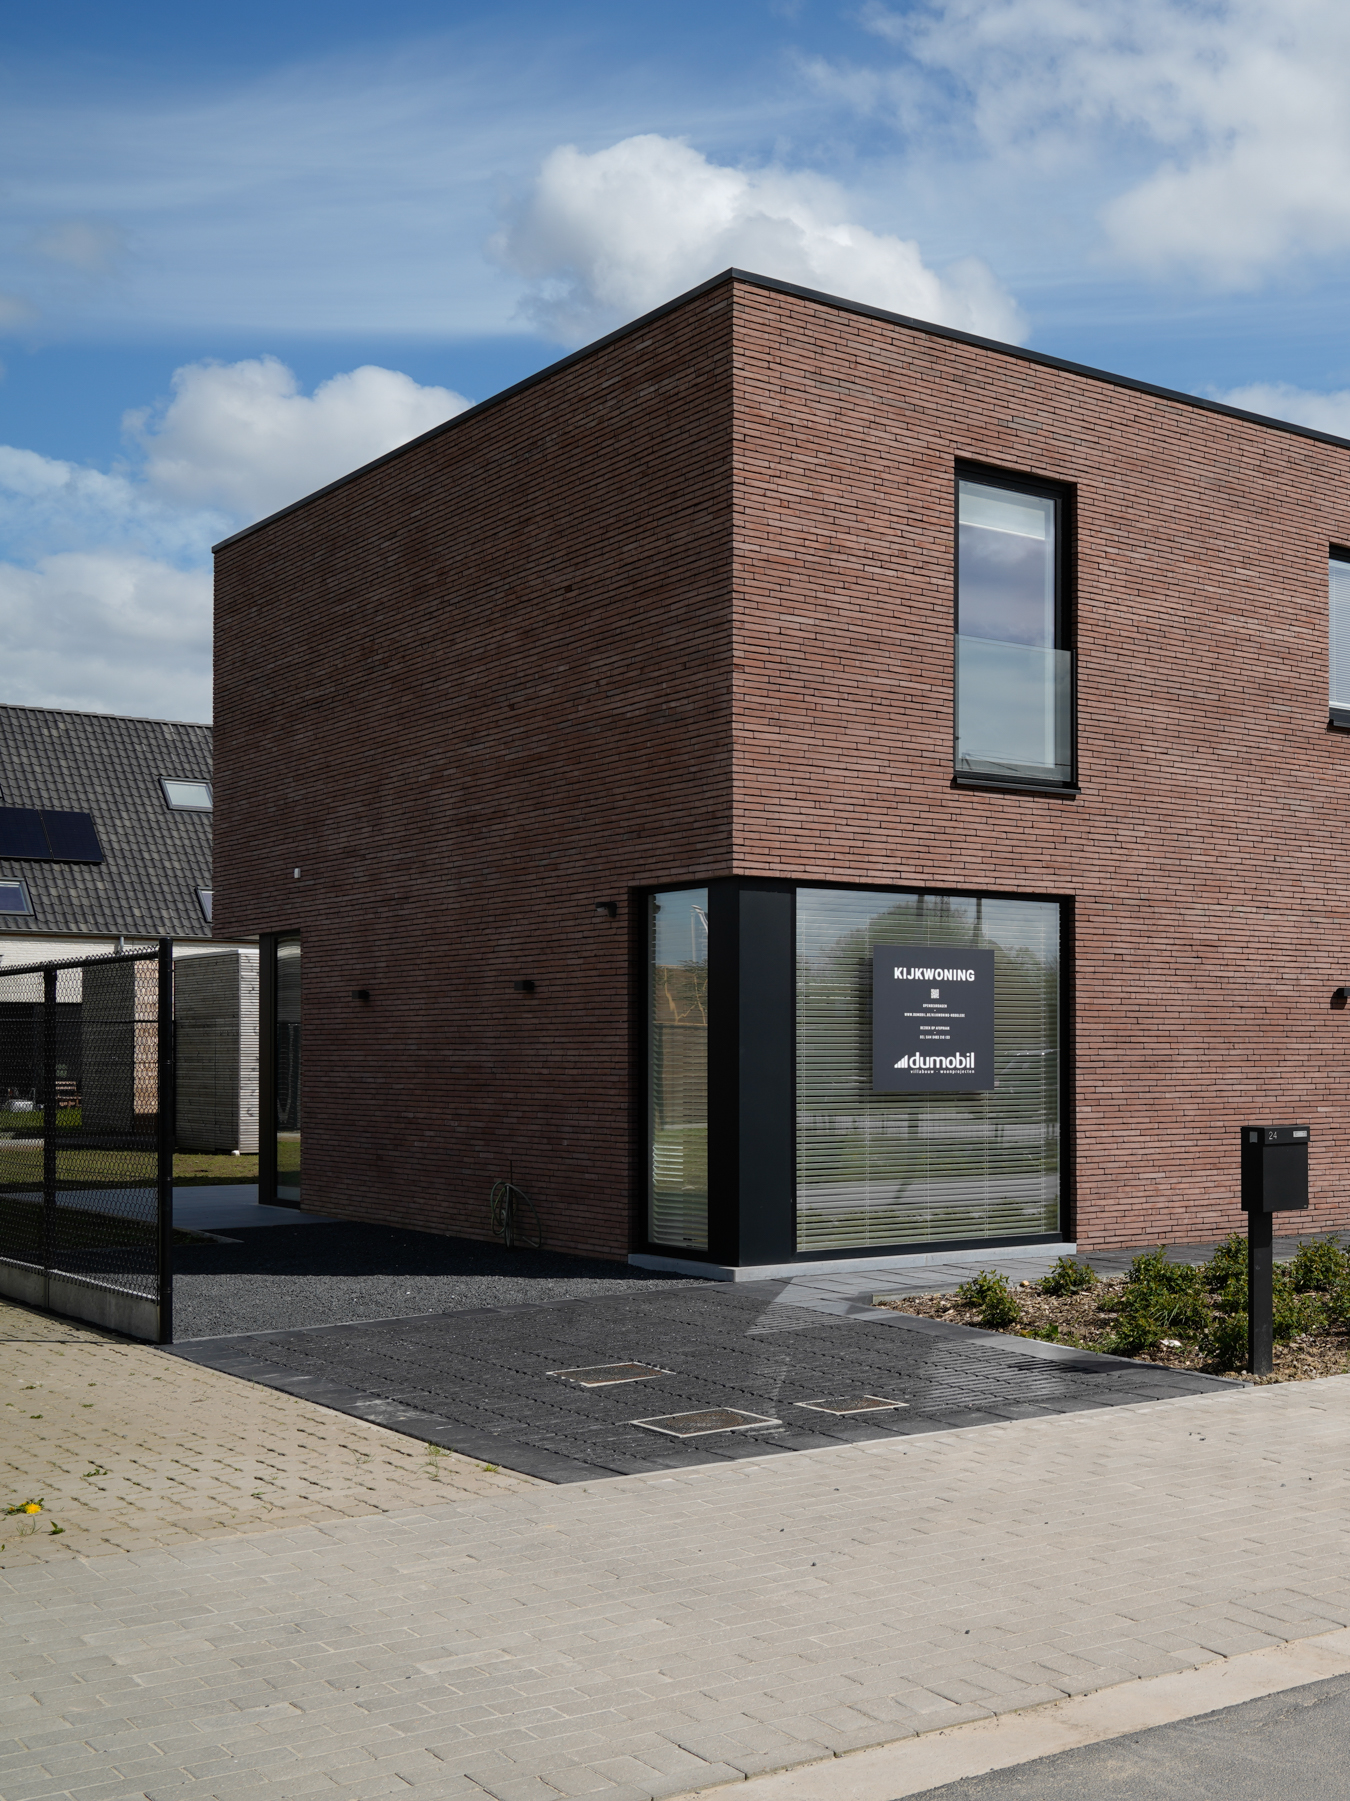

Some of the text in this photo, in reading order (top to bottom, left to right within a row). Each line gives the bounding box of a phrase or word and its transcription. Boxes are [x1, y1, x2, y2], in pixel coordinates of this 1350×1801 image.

[894, 967, 975, 981] KIJKWONING
[909, 1052, 975, 1068] dumobil
[1268, 1131, 1278, 1140] 24
